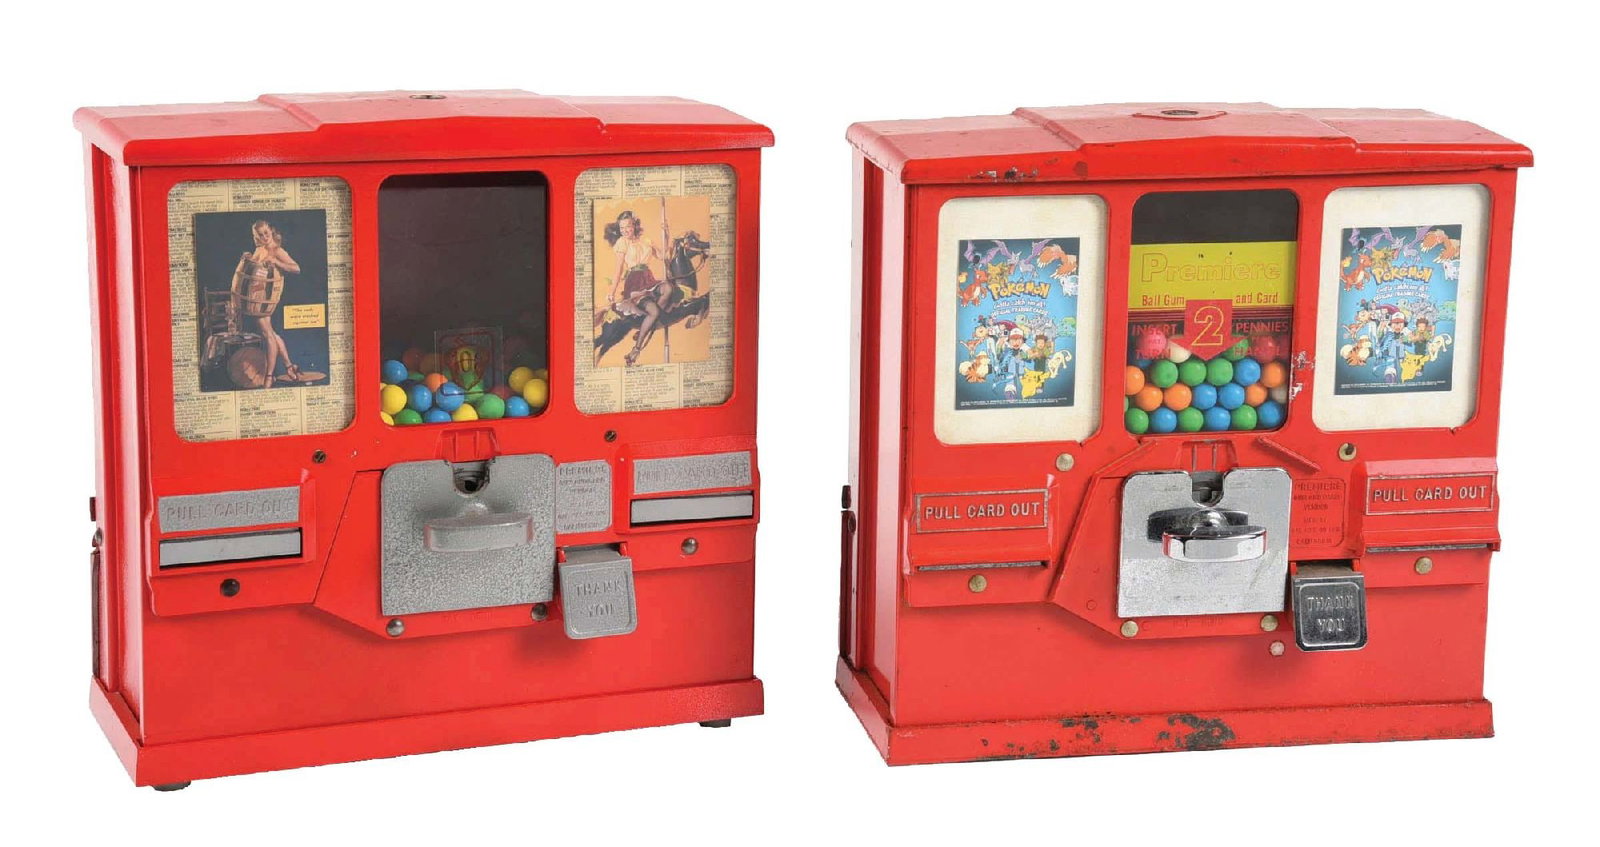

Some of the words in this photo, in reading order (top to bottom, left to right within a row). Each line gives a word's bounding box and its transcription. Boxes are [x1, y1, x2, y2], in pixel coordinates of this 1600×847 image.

[1141, 252, 1281, 283] Premiere
[1142, 294, 1161, 307] Ball
[1163, 294, 1185, 306] Gum
[1235, 292, 1253, 304] and
[1256, 292, 1279, 304] Card
[1132, 322, 1178, 337] INSERT
[1235, 320, 1289, 334] PENNIES
[1191, 305, 1225, 347] 2
[1373, 489, 1408, 503] PULL
[1415, 487, 1453, 501] CARD
[1459, 485, 1488, 499] OUT
[166, 506, 207, 522] PULL
[213, 501, 255, 517] CARD
[260, 497, 294, 515] OUT
[925, 506, 961, 520] PULL
[966, 503, 1005, 518] CARD
[1011, 501, 1041, 517] OUT
[575, 580, 621, 597] THANK
[586, 602, 614, 618] YOU
[1307, 594, 1355, 612] THANK
[1316, 617, 1346, 632] YOU
